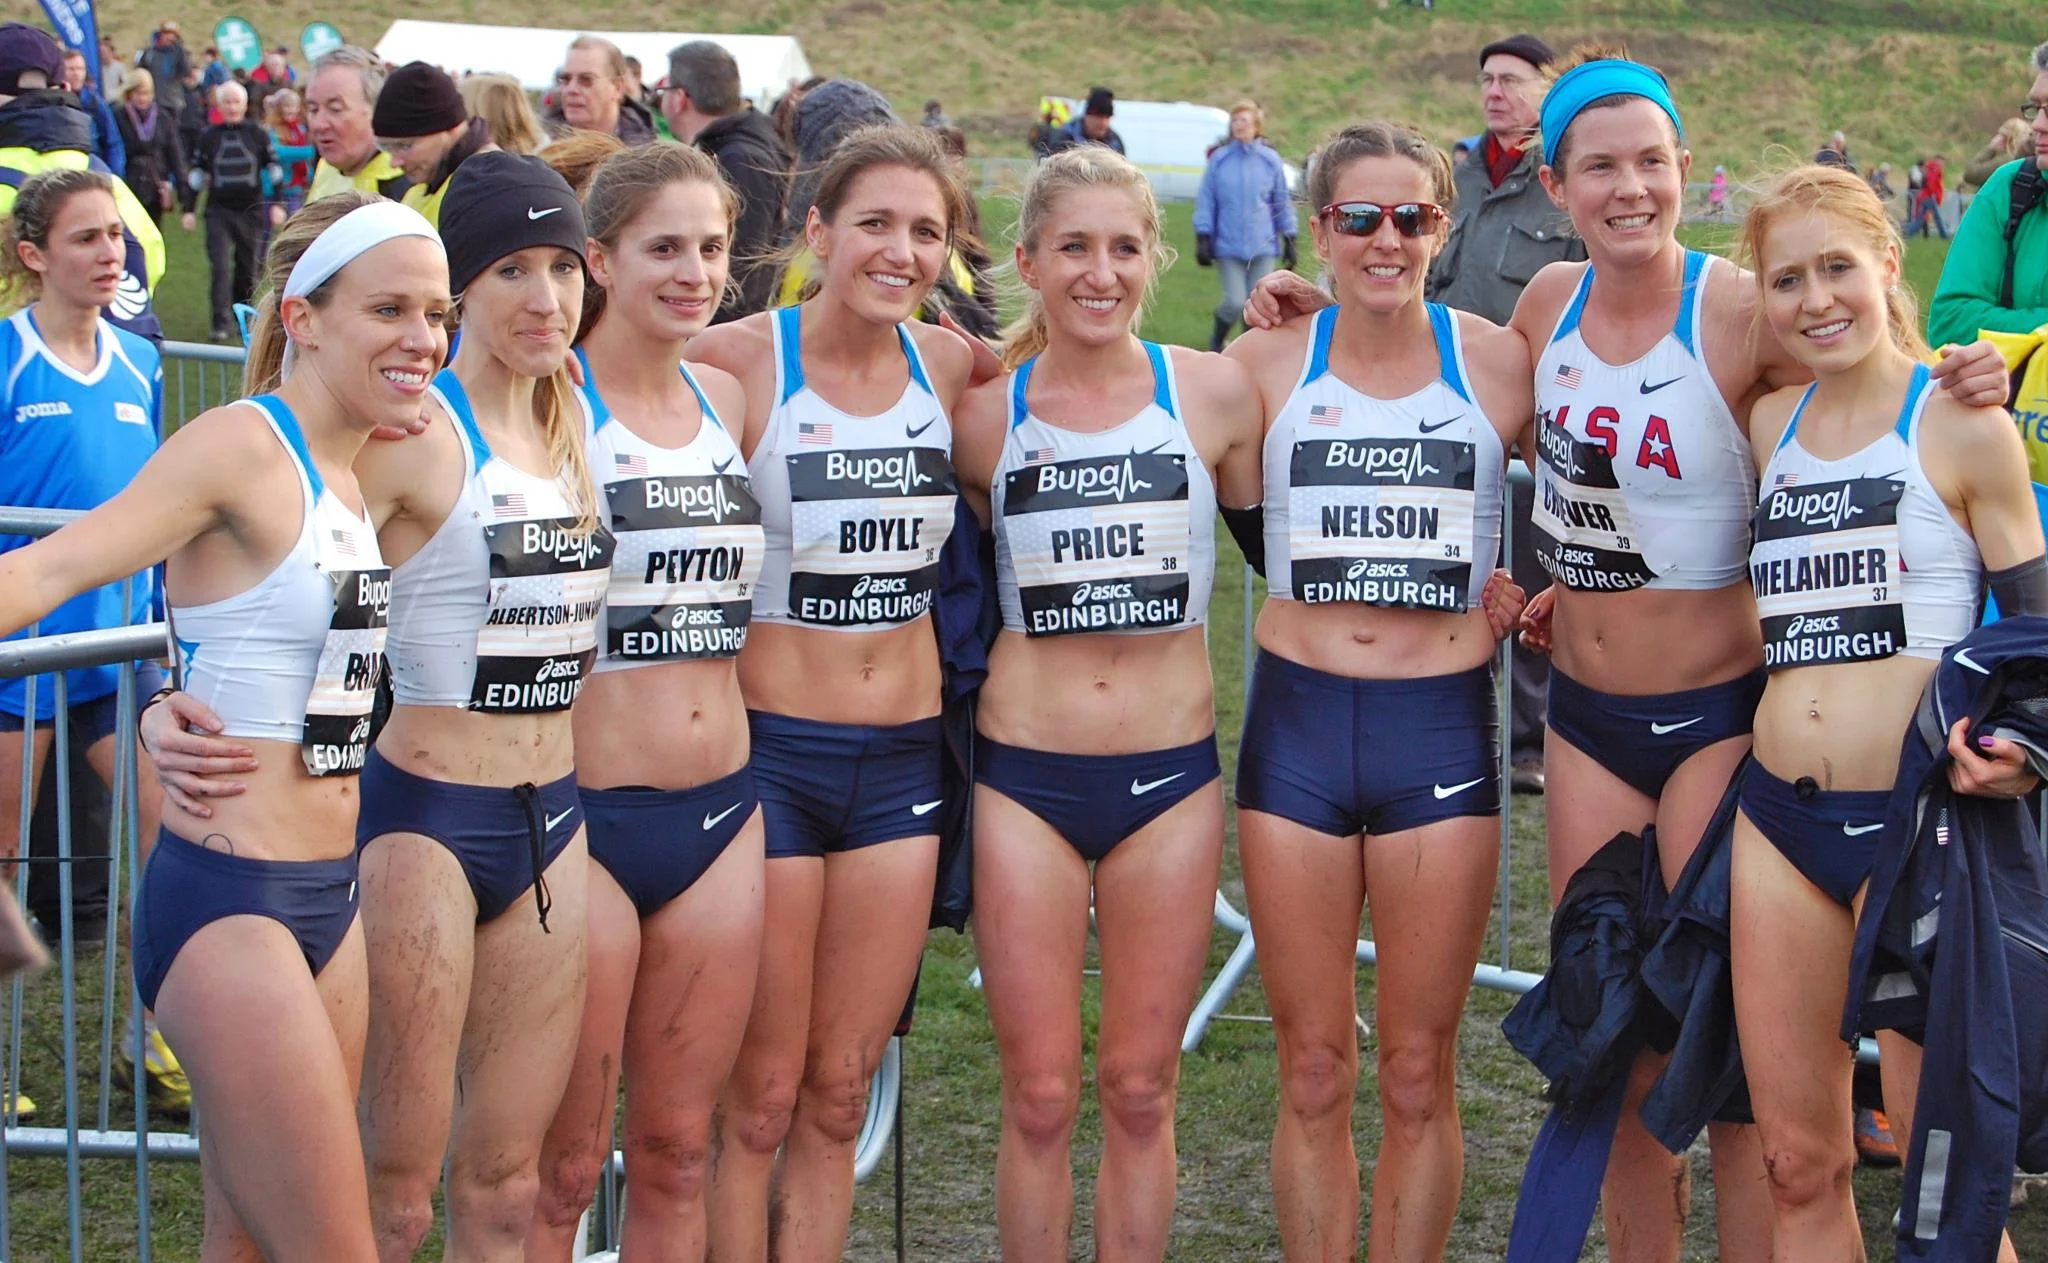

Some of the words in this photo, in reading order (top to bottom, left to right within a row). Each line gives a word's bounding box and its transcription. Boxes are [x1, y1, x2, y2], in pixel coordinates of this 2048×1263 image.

[826, 452, 903, 485] Bupa
[1325, 441, 1409, 474] Bupa
[1037, 464, 1119, 495] Bupa
[645, 479, 714, 514] Bupa
[1769, 490, 1840, 523] Bupa
[839, 517, 924, 554] BOYLE
[1321, 505, 1439, 540] NELSON
[523, 523, 583, 559] Bupa
[1051, 522, 1145, 563] PRICE
[1444, 544, 1461, 558] 34
[1616, 535, 1631, 550] 39
[644, 546, 744, 584] PEYTON
[1162, 556, 1177, 571] 38
[1365, 563, 1409, 578] asics
[1537, 549, 1646, 589] EDINBURGH
[1562, 548, 1595, 566] asics
[868, 577, 906, 595] asics
[1754, 548, 1887, 600] MELANDER
[737, 583, 748, 597] 35
[801, 589, 932, 621] EDINBURGH
[1089, 583, 1132, 601] asics
[1303, 580, 1455, 608] EDINBURGH
[1872, 587, 1887, 602] 37
[686, 608, 723, 626] asics
[1032, 598, 1178, 632] EDINBURGH
[1802, 615, 1839, 634] asics
[622, 626, 748, 655] EDINBURGH
[1763, 631, 1892, 666] DINBURGH
[549, 658, 580, 679] asics
